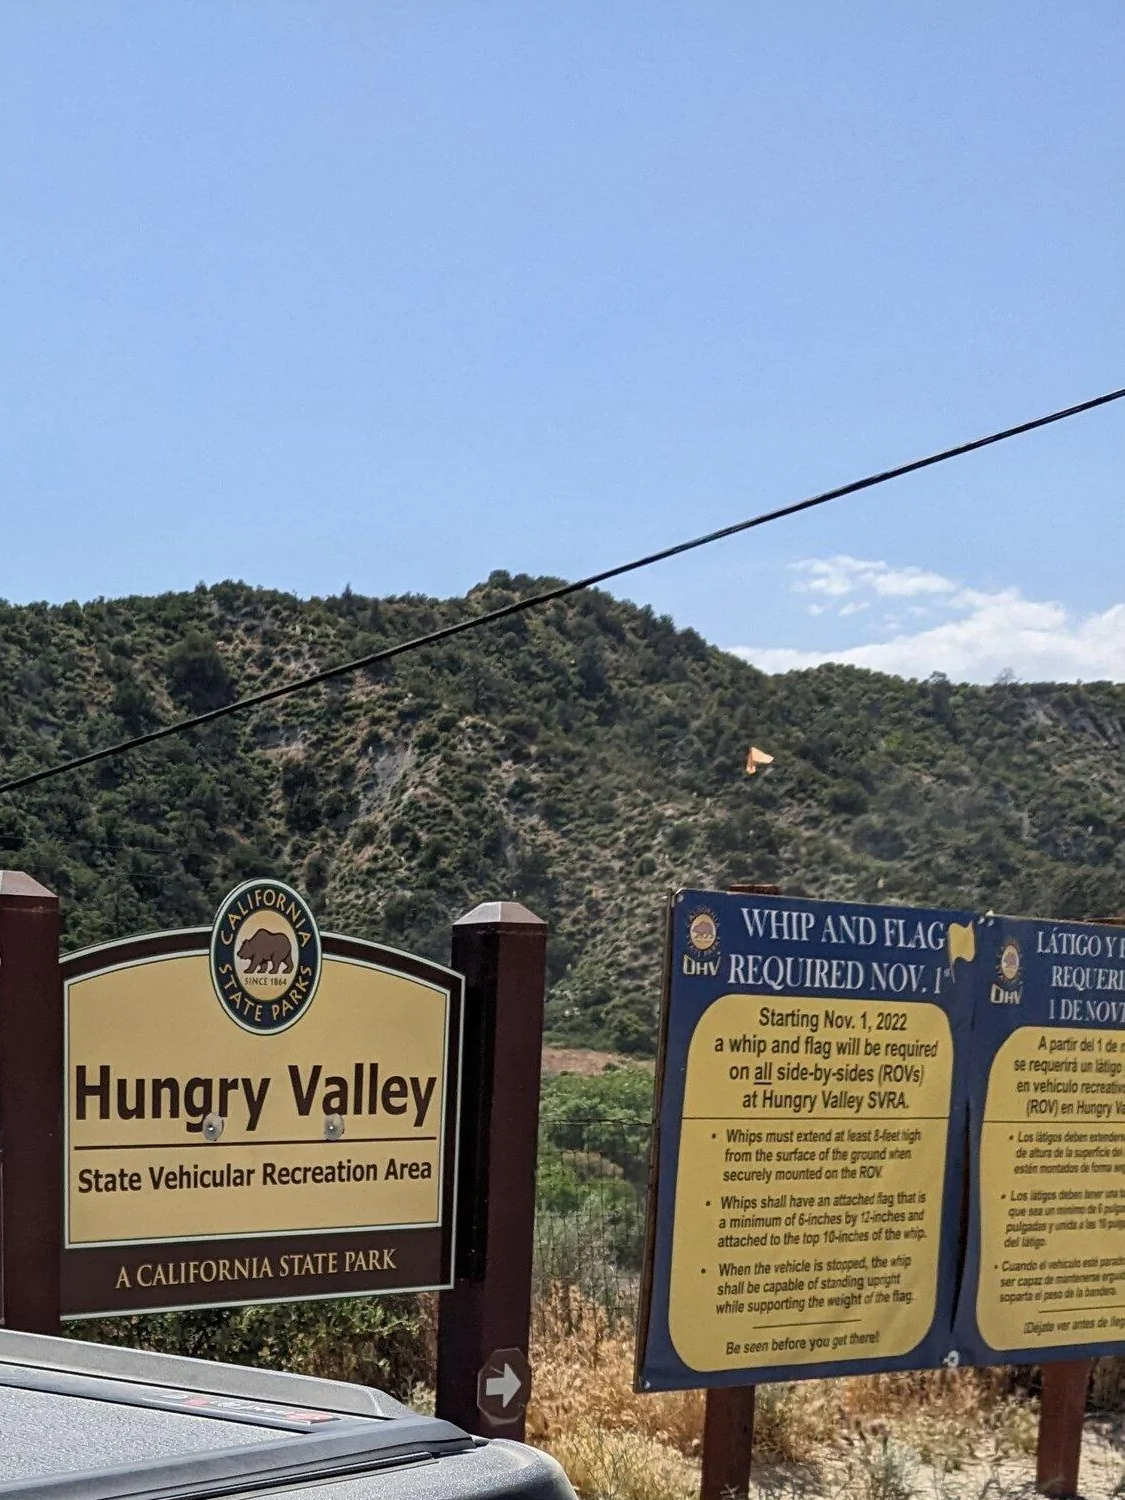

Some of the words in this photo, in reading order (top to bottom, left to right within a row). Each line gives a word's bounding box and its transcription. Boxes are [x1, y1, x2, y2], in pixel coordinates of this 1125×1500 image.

[221, 889, 311, 947] CALIFORNIA
[741, 908, 815, 941] WHIP
[821, 914, 875, 945] AND
[884, 918, 944, 950] FLAG
[1037, 927, 1101, 957] LÁTIGO
[1105, 937, 1117, 958] Y
[684, 954, 720, 976] OHV
[727, 954, 863, 990] REQUIRED
[870, 962, 926, 993] NOV.
[219, 964, 262, 1021] STATE
[272, 966, 311, 1020] PARKS
[991, 984, 1023, 1004] OHV
[759, 1007, 819, 1030] Starting
[825, 1012, 854, 1029] Nov.
[860, 1012, 871, 1033] 1,
[877, 1013, 907, 1030] 2022
[1060, 999, 1082, 1020] DE
[715, 1038, 723, 1052] a
[729, 1034, 766, 1057] whip
[772, 1036, 800, 1053] and
[805, 1037, 831, 1059] flag
[836, 1038, 860, 1055] will
[864, 1039, 881, 1056] be
[884, 1040, 938, 1059] required
[1038, 1036, 1047, 1050] A
[1050, 1038, 1077, 1053] partir
[1080, 1038, 1094, 1051] del
[1097, 1038, 1102, 1050] 1
[1106, 1039, 1117, 1052] de
[730, 1065, 749, 1080] on
[755, 1062, 772, 1082] all
[777, 1063, 873, 1085] side-by-sides
[878, 1065, 924, 1086] (ROVs)
[1014, 1060, 1025, 1071] se
[1081, 1063, 1093, 1072] un
[1017, 1081, 1029, 1092] en
[76, 1065, 271, 1132] Hungry
[288, 1063, 436, 1127] Valley
[743, 1091, 757, 1107] at
[762, 1090, 816, 1113] Hungry
[822, 1091, 863, 1113] Valley
[867, 1091, 909, 1109] SVRA.
[1027, 1099, 1057, 1117] (ROV)
[1061, 1103, 1073, 1114] en
[1077, 1101, 1112, 1118] Hungry
[727, 1129, 762, 1145] Whips
[766, 1130, 793, 1142] must
[797, 1129, 831, 1142] extend
[834, 1130, 845, 1142] at
[847, 1129, 871, 1142] least
[725, 1149, 752, 1162] from
[756, 1149, 773, 1161] the
[776, 1148, 815, 1161] surface
[819, 1148, 830, 1161] of
[832, 1148, 847, 1161] the
[851, 1147, 886, 1163] ground
[78, 1169, 141, 1192] State
[149, 1164, 255, 1189] Vehicular
[262, 1160, 378, 1185] Recreation
[385, 1159, 431, 1180] Area
[723, 1169, 771, 1184] securely
[775, 1167, 822, 1180] mounted
[825, 1170, 838, 1179] on
[841, 1167, 856, 1179] the
[721, 1197, 757, 1212] Whips
[761, 1195, 786, 1208] shall
[790, 1195, 814, 1207] have
[818, 1196, 830, 1206] an
[833, 1193, 874, 1206] attached
[876, 1192, 894, 1207] flag
[897, 1192, 915, 1204] that
[918, 1192, 926, 1203] is
[719, 1218, 726, 1228] a
[730, 1215, 781, 1228] minimum
[784, 1213, 796, 1227] of
[798, 1211, 841, 1225] 6-inches
[845, 1211, 857, 1225] by
[907, 1210, 924, 1221] and
[718, 1233, 767, 1247] attached
[770, 1234, 780, 1245] to
[784, 1232, 799, 1245] the
[803, 1232, 819, 1246] top
[872, 1228, 882, 1240] of
[885, 1228, 901, 1240] the
[115, 1267, 130, 1289] A
[137, 1257, 274, 1287] CALIFORNIA
[280, 1252, 338, 1276] STATE
[345, 1249, 397, 1272] PARK
[718, 1263, 751, 1276] When
[754, 1262, 770, 1274] the
[775, 1260, 810, 1273] vehicle
[814, 1259, 823, 1271] is
[872, 1256, 887, 1268] the
[717, 1282, 744, 1295] shall
[747, 1281, 760, 1294] be
[763, 1279, 804, 1295] capable
[808, 1277, 819, 1290] of
[823, 1275, 864, 1290] standing
[716, 1301, 744, 1315] while
[748, 1297, 804, 1313] supporting
[809, 1295, 824, 1308] the
[827, 1293, 861, 1309] weight
[864, 1291, 874, 1304] of
[875, 1291, 890, 1304] the
[726, 1342, 741, 1355] Be
[743, 1341, 769, 1353] seen
[772, 1336, 806, 1351] before
[809, 1338, 830, 1351] you
[832, 1336, 847, 1349] get
